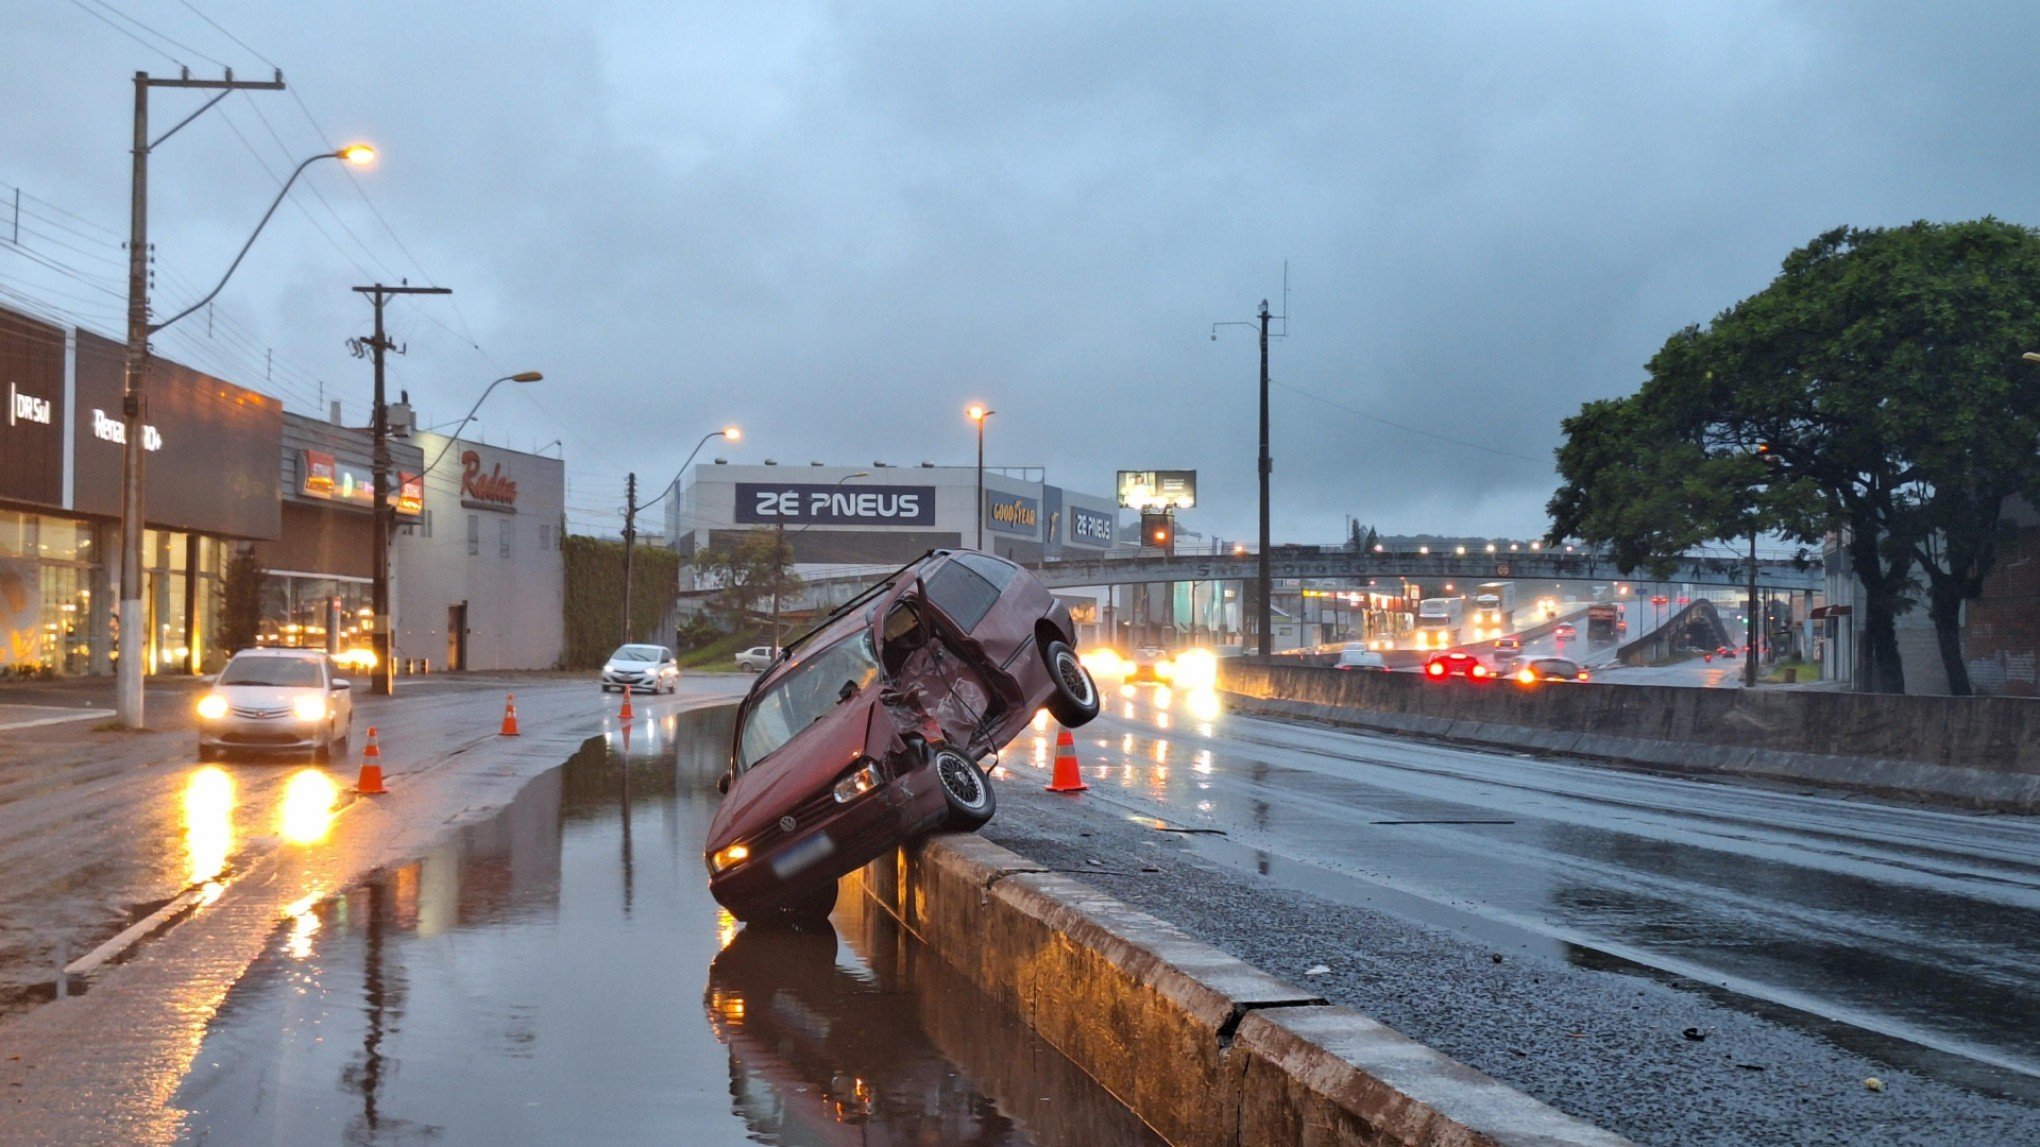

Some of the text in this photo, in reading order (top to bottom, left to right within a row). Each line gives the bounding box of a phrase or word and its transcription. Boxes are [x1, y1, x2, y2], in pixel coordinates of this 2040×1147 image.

[811, 493, 920, 518] PNEUS
[993, 500, 1036, 526] GOODYEAR
[1088, 516, 1110, 540] PNEUS
